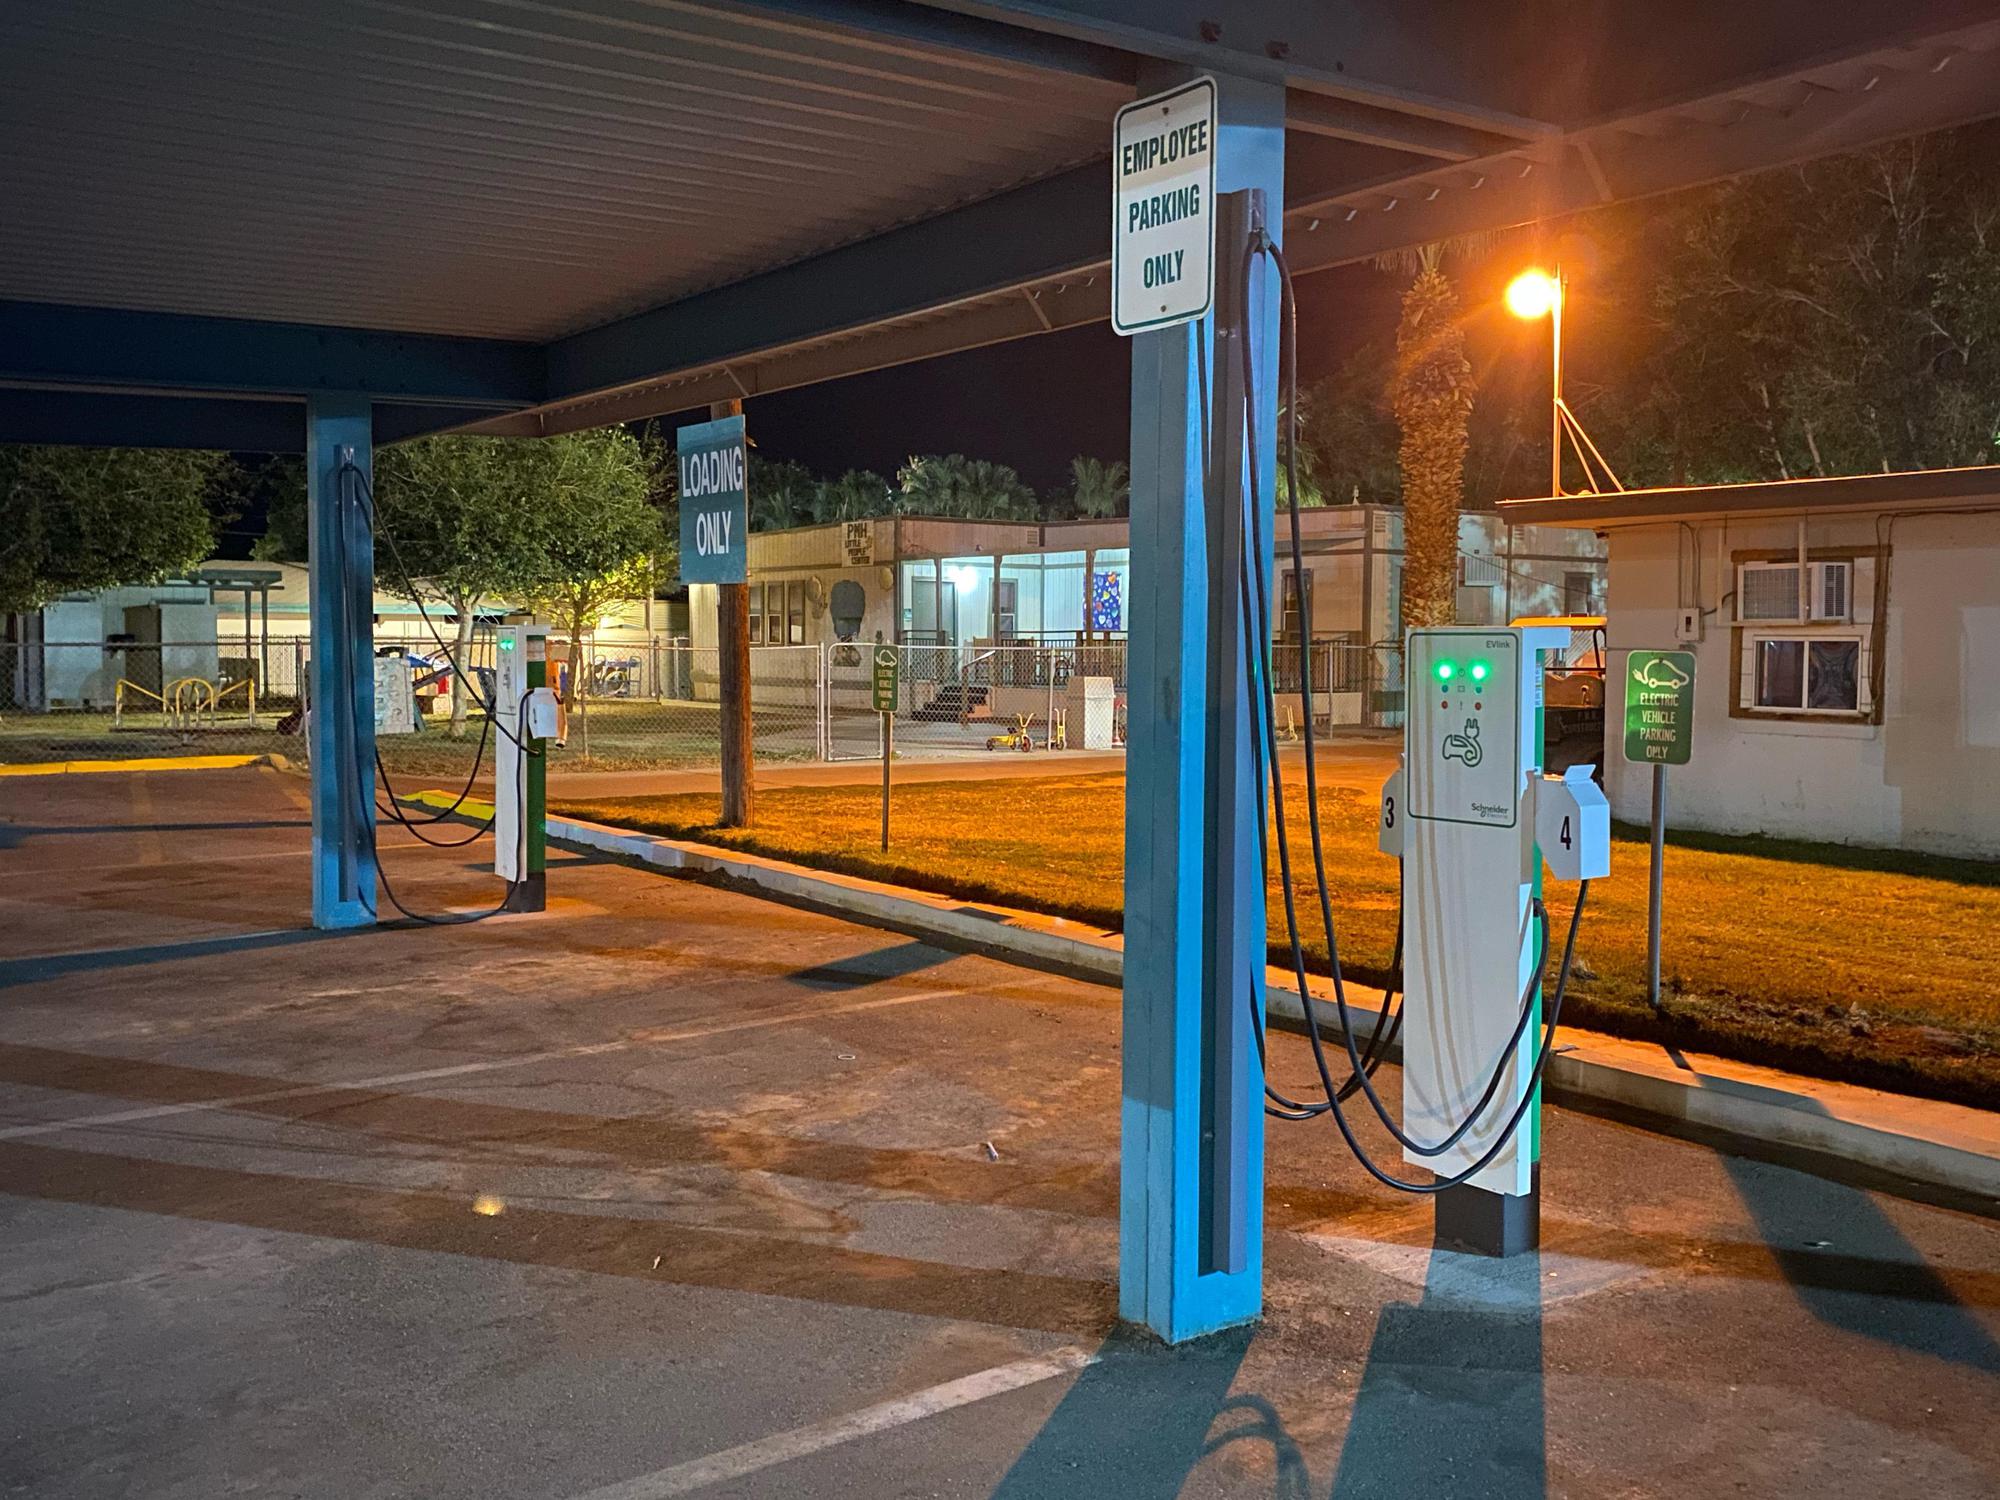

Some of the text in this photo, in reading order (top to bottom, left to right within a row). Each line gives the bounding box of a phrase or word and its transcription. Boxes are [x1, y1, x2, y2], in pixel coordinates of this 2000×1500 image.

[1123, 119, 1207, 176] EMPLOYEE
[1129, 184, 1200, 233] PARKING
[1143, 249, 1184, 288] ONLY
[681, 446, 743, 498] LOADING
[696, 510, 732, 556] ONLY
[847, 522, 867, 539] PNH
[1486, 640, 1511, 649] EVlink
[1640, 692, 1679, 706] ELECTRIC
[1642, 710, 1676, 724] VEHICLE
[1640, 727, 1676, 742] PARKING
[1646, 745, 1668, 759] ONLY
[1385, 796, 1395, 828] 3
[1471, 802, 1508, 818] Schneider
[1560, 815, 1572, 850] 4
